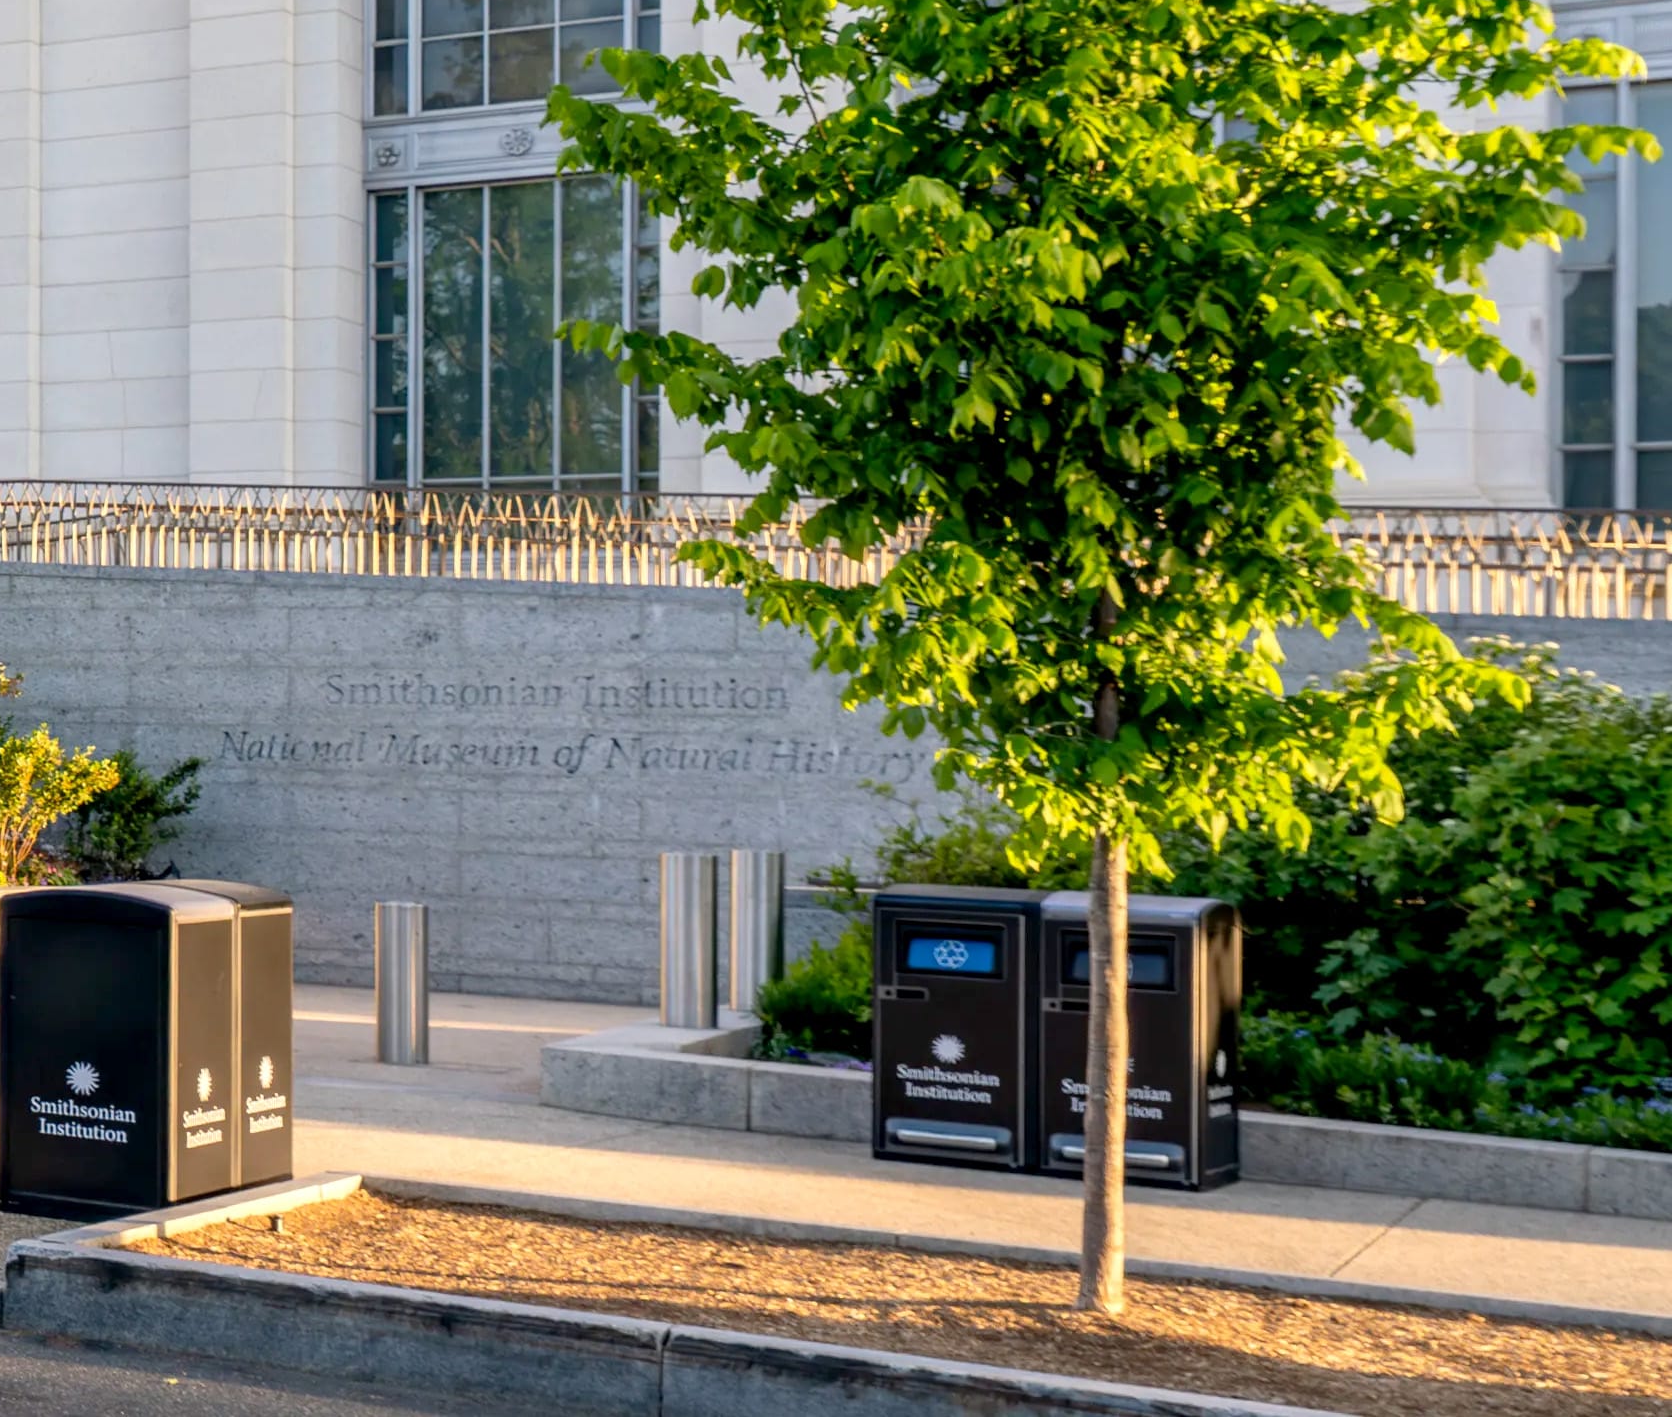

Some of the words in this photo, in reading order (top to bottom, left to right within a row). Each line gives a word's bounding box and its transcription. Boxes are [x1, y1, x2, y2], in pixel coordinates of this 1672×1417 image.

[325, 673, 563, 709] Smithsonian
[580, 674, 789, 711] Institution
[218, 730, 367, 763] National
[380, 733, 541, 766] Museum
[553, 732, 595, 774] of
[605, 735, 754, 772] Natural
[896, 1063, 1000, 1087] Smithsonian
[905, 1081, 992, 1104] Institution
[1061, 1078, 1172, 1102] Smonian
[30, 1096, 137, 1124] Smithsonian
[1070, 1096, 1163, 1120] Intion
[38, 1118, 129, 1144] Institution
